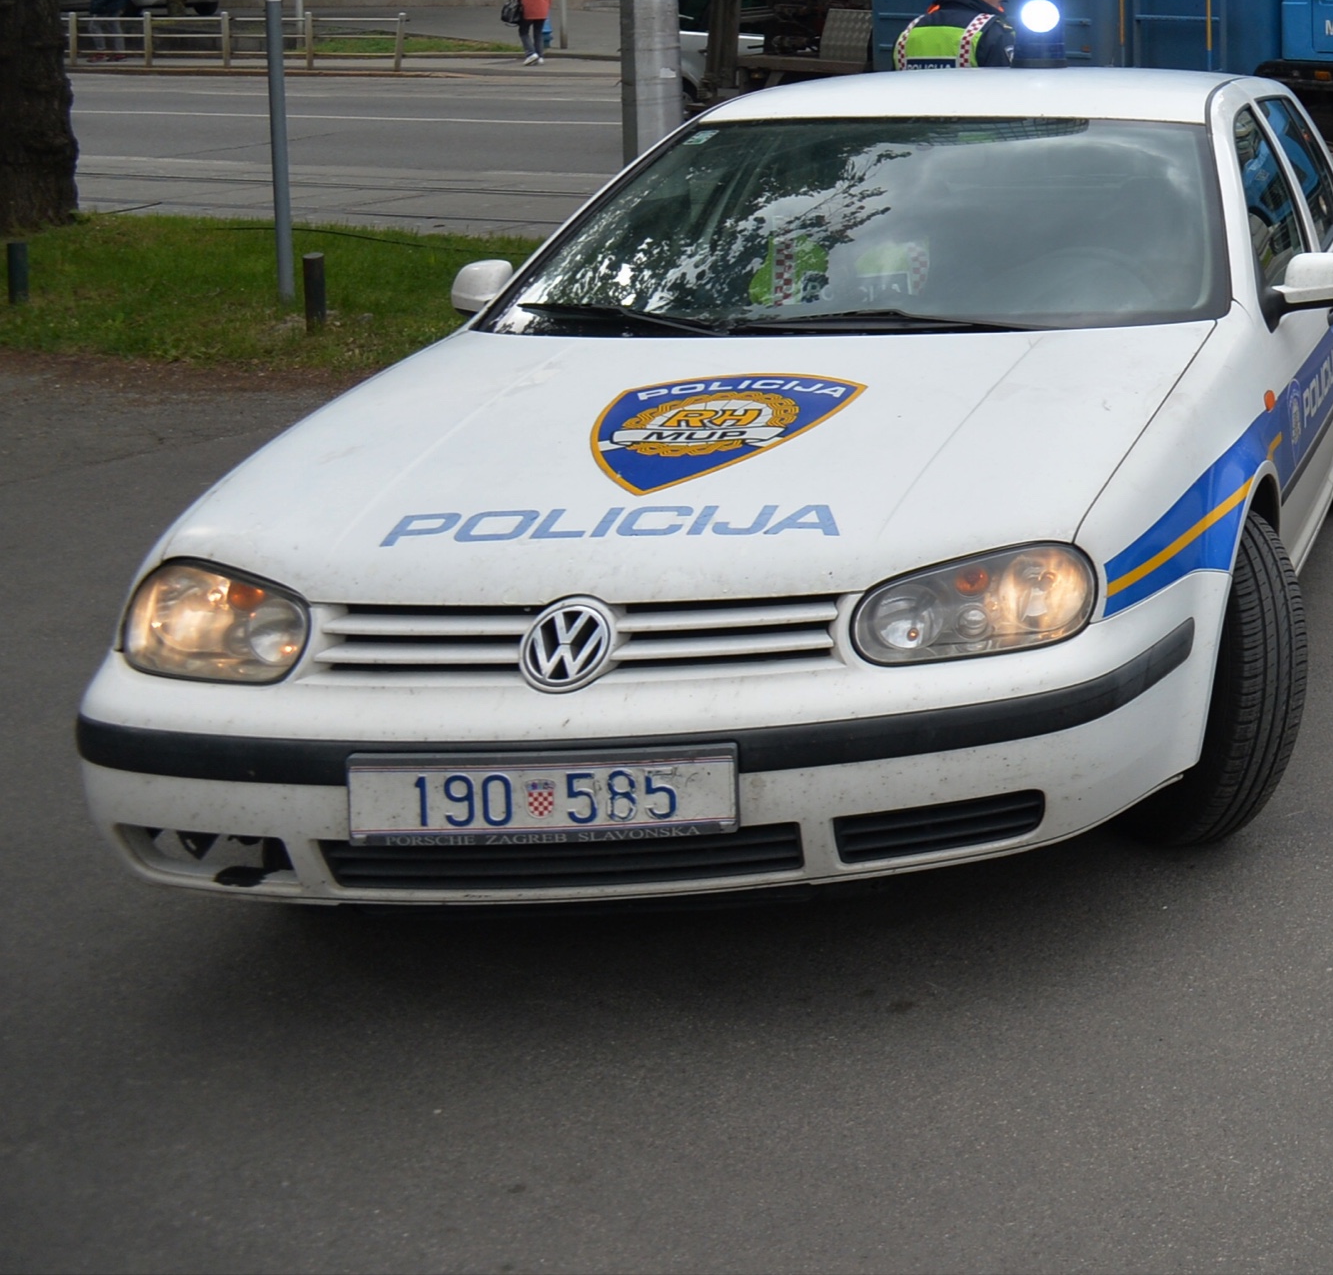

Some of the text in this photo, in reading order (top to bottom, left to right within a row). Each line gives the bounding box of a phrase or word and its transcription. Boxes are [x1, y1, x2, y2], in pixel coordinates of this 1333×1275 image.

[636, 378, 847, 402] POLICIJA
[664, 407, 763, 428] RH
[641, 428, 748, 444] MUP
[379, 504, 841, 548] POLICIJA
[414, 766, 678, 828] 190 585
[385, 825, 701, 847] PORSCHE ZAGREB SLAVONSKA
